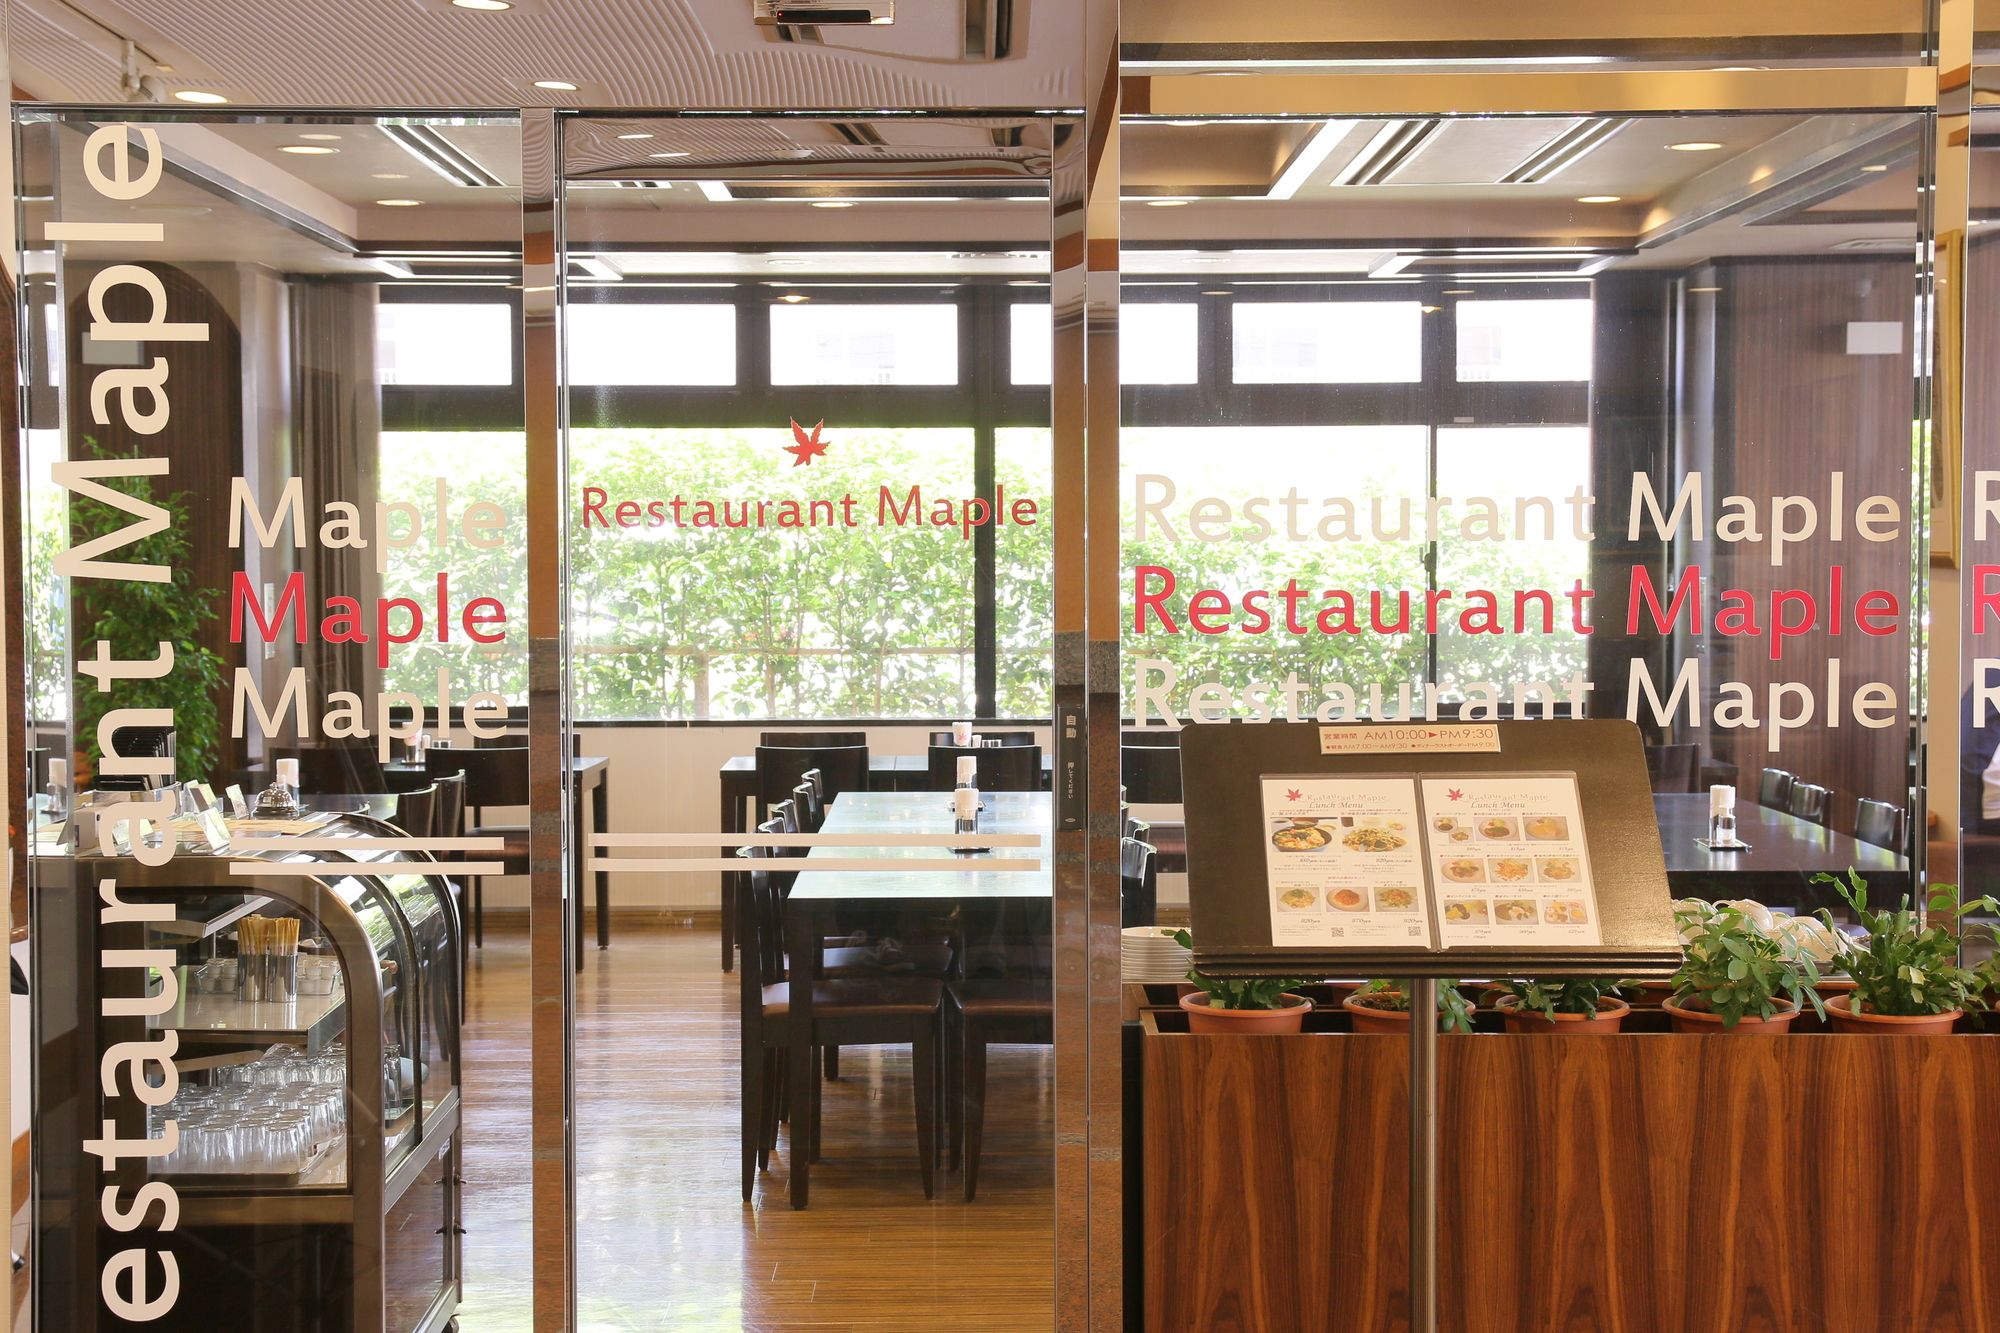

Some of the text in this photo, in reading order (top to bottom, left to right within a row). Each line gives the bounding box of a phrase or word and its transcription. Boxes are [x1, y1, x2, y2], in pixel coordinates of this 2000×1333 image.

[44, 122, 210, 584] Maple
[228, 475, 507, 573] Maple
[583, 485, 1038, 540] Restaurant Maple
[1135, 471, 1901, 567] Restaurant Maple
[229, 571, 508, 668] Maple
[1134, 565, 1900, 661] Restaurant Maple
[231, 664, 510, 763] Maple
[1066, 715, 1077, 739] 自動
[1134, 657, 1897, 753] Restaurant Maple
[1364, 729, 1427, 741] AM10:00
[1307, 793, 1387, 802] Restaurant Maple
[1309, 801, 1364, 809] Lunch Menu
[1468, 793, 1549, 802] Restaurant Maple
[1470, 801, 1526, 809] Lunch Menu
